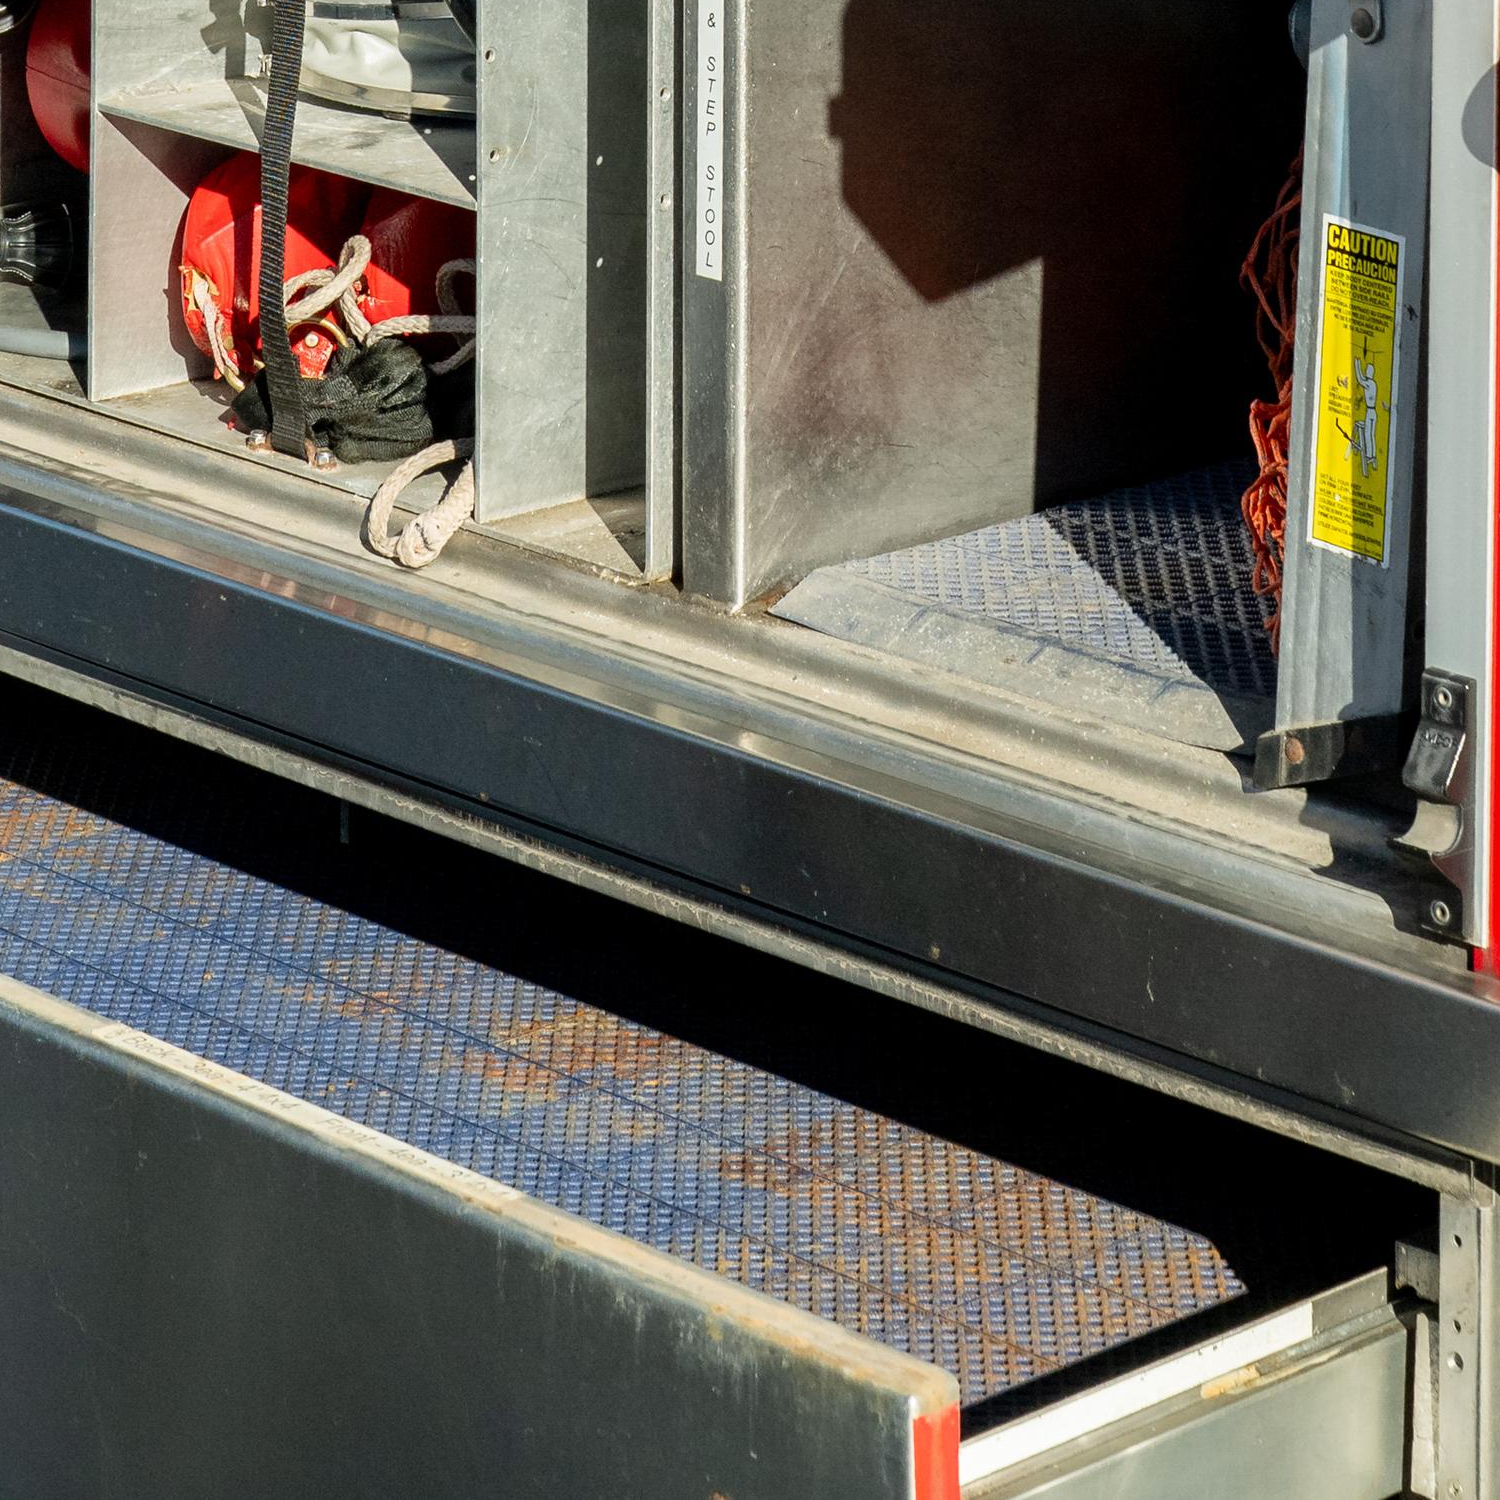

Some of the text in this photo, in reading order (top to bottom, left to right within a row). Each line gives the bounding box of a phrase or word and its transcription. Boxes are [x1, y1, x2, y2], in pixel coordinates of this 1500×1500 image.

[707, 11, 716, 28] &
[706, 55, 716, 134] STEP
[705, 165, 715, 268] STOOL
[1328, 224, 1398, 265] CAUTION
[1328, 249, 1396, 283] PRECAUCIÓN
